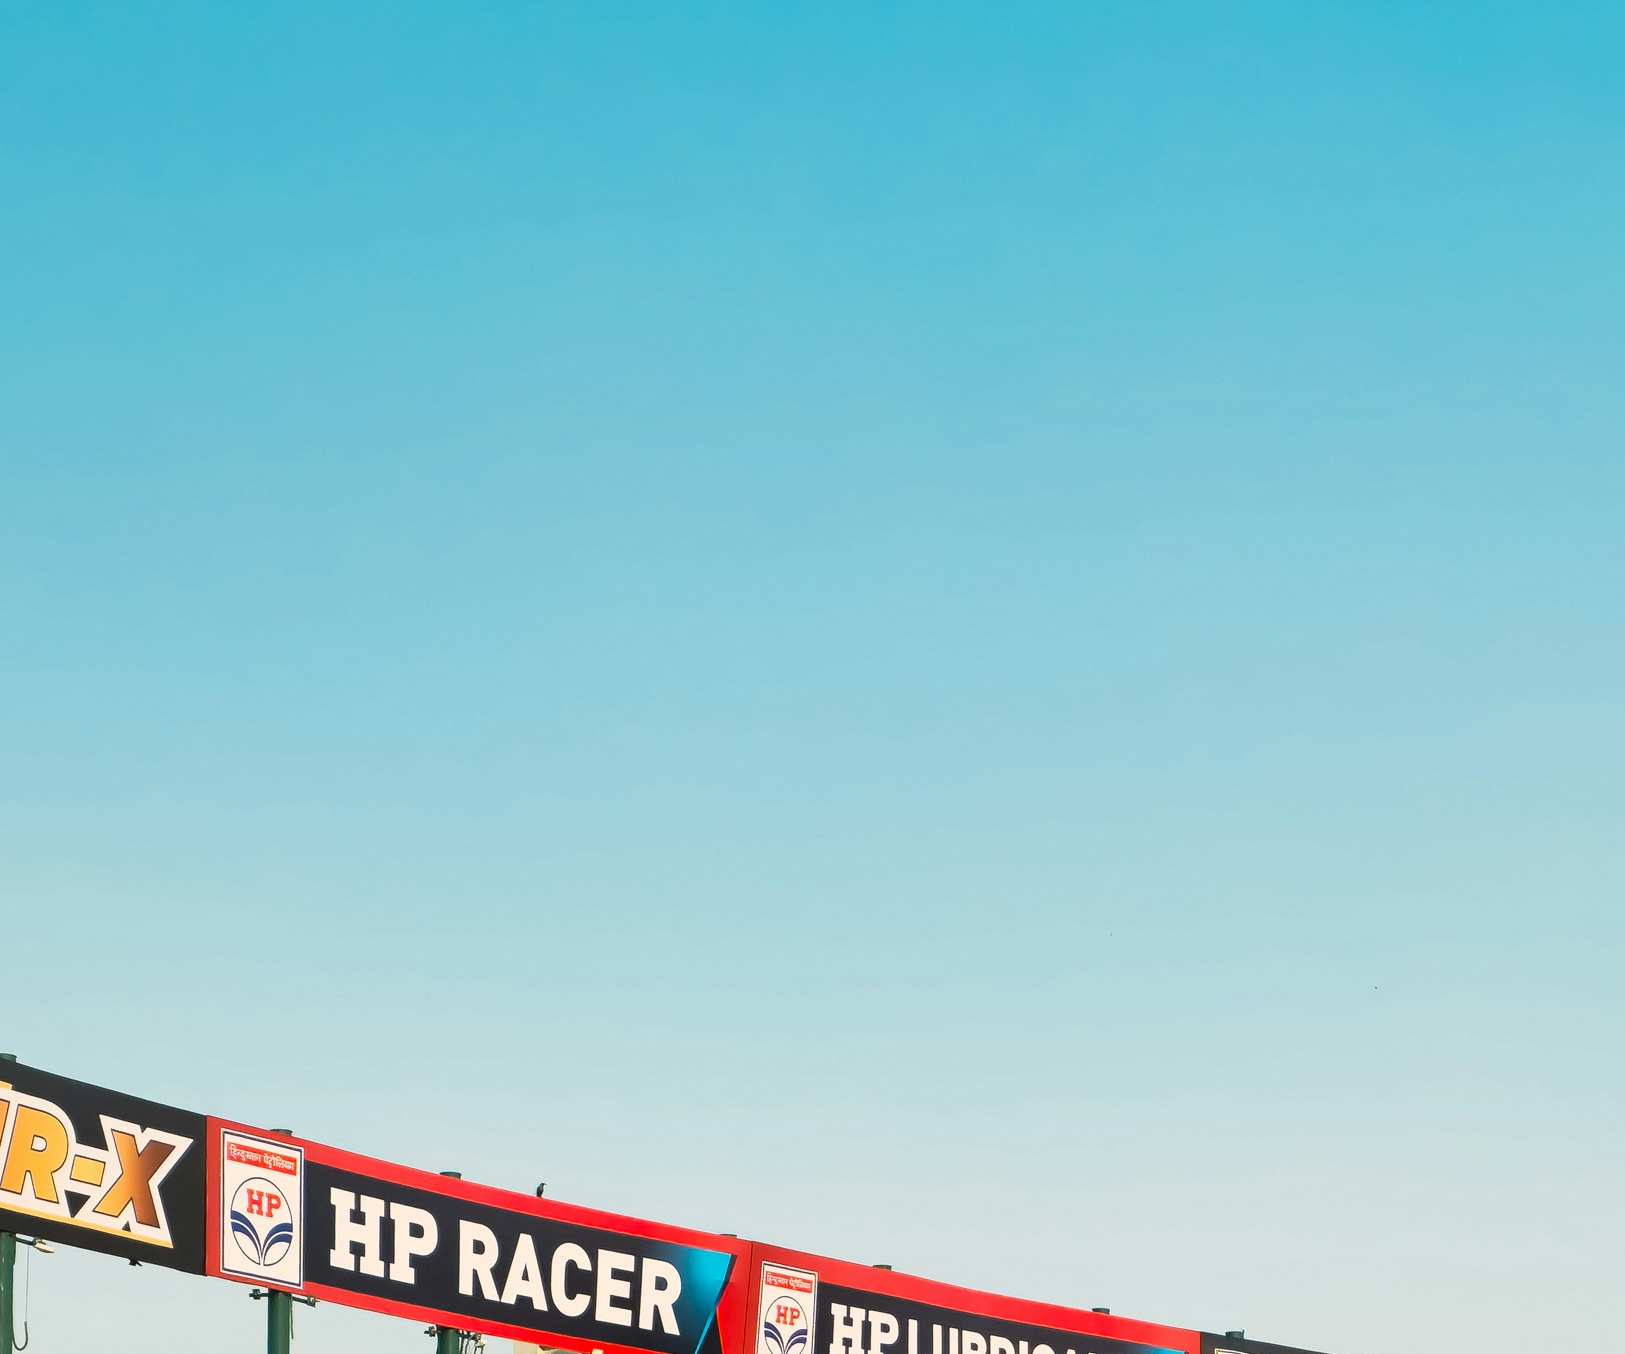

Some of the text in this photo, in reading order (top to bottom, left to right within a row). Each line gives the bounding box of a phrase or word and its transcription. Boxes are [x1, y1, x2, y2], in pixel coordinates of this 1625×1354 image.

[247, 1189, 281, 1218] HP
[330, 1187, 681, 1335] HP RACER
[777, 1305, 800, 1325] HP
